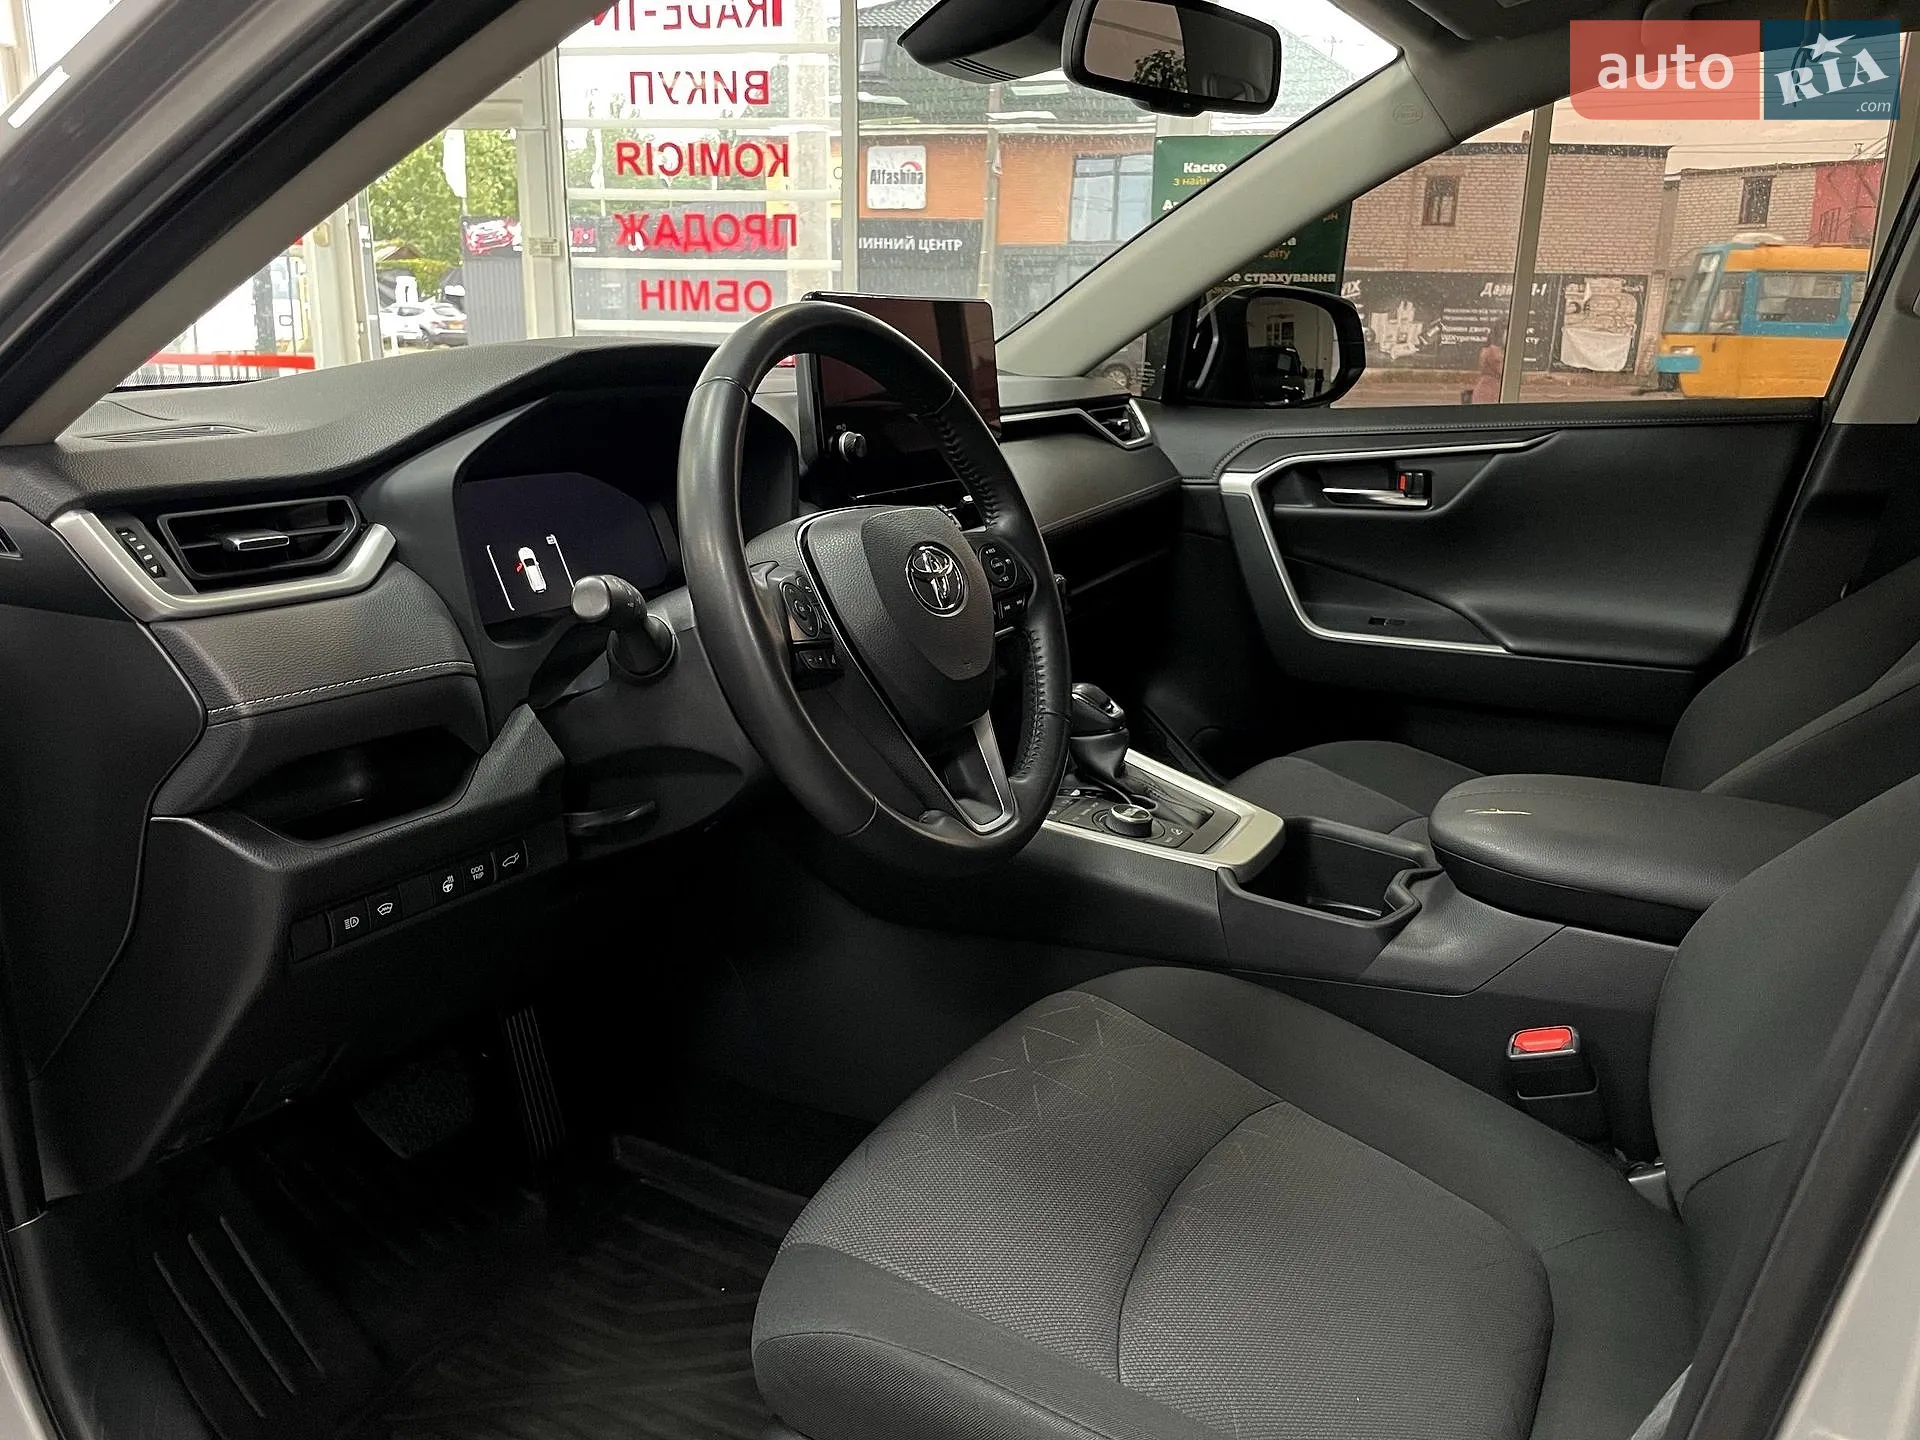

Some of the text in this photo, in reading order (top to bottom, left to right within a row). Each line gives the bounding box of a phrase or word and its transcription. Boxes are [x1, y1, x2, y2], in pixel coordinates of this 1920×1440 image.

[1183, 162, 1227, 174] Каско
[870, 169, 924, 185] Alfashina
[918, 238, 963, 254] ЦЕНТР
[1243, 272, 1336, 285] страхування
